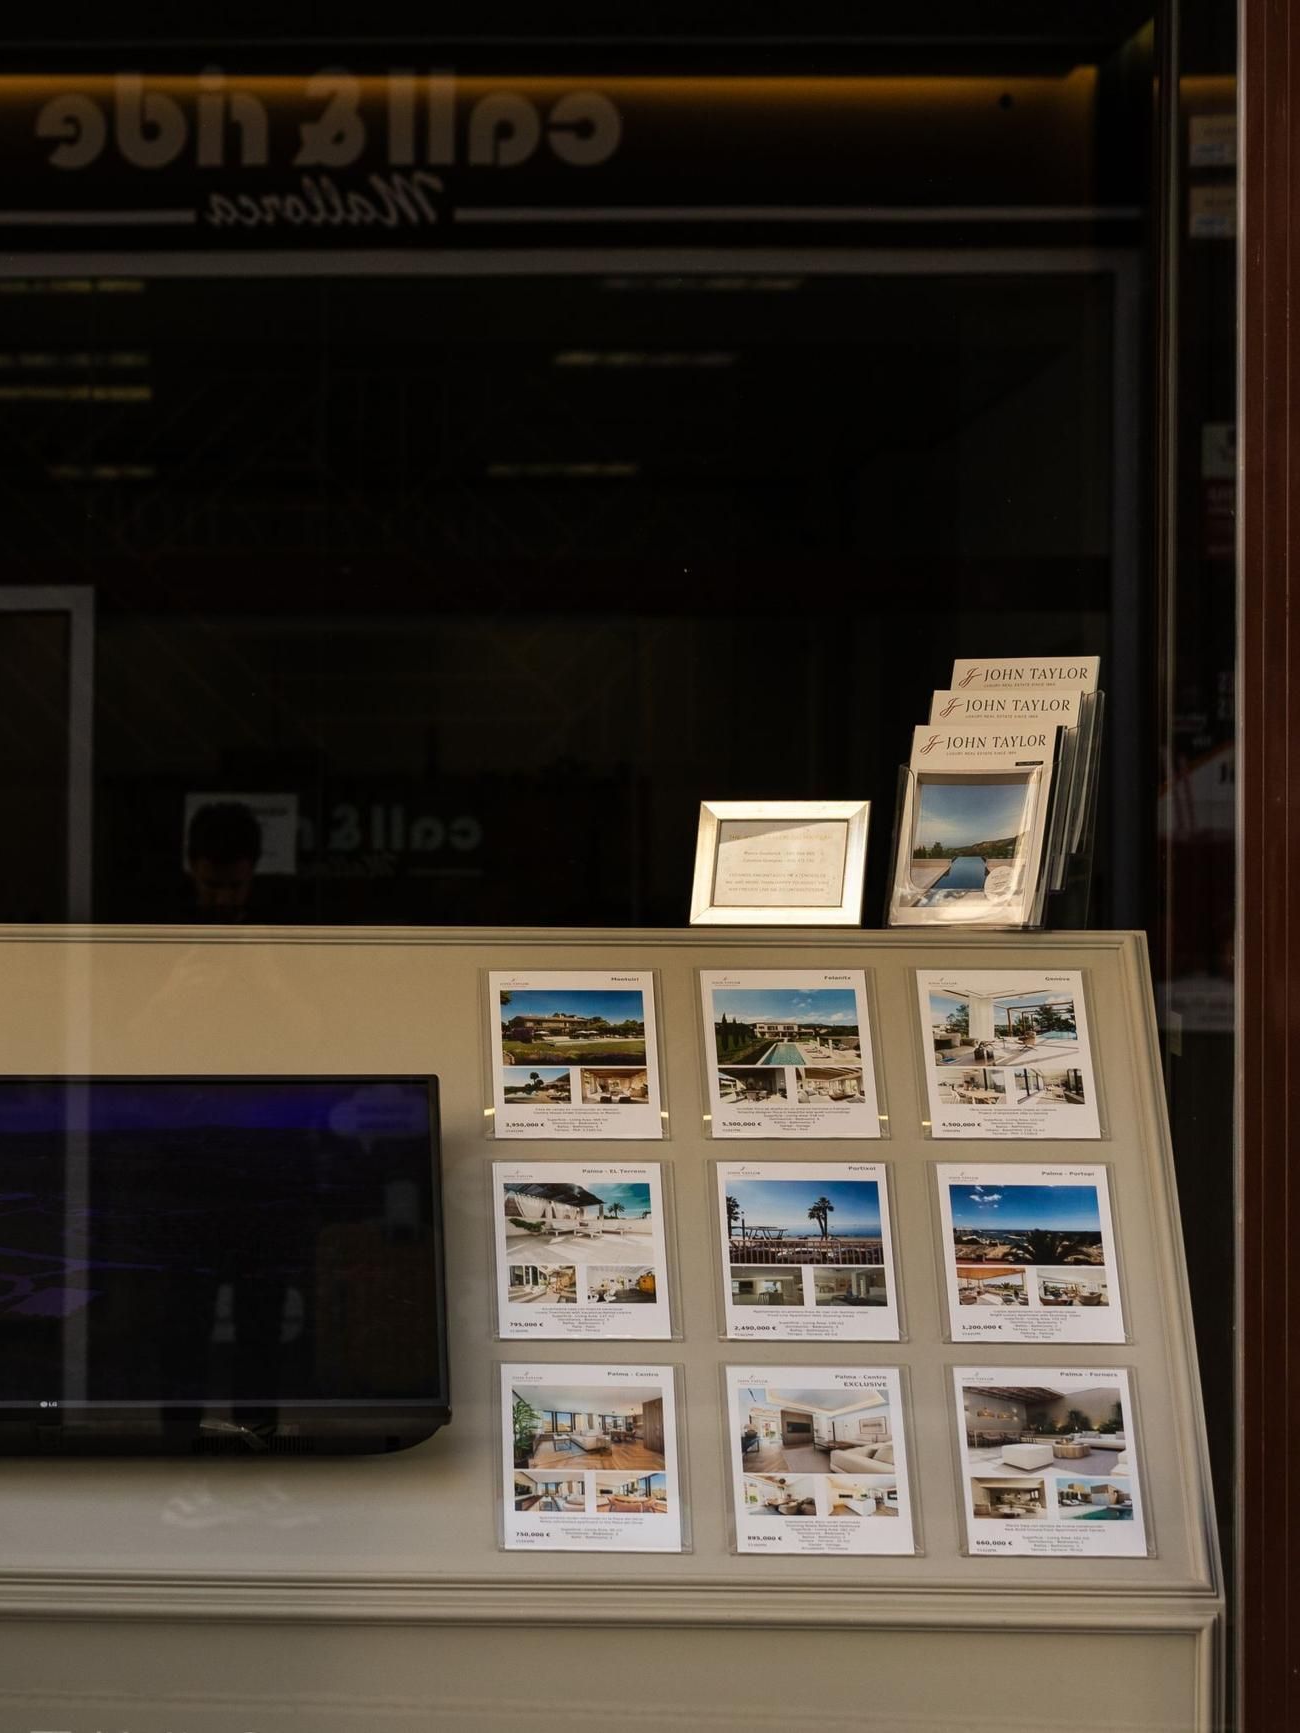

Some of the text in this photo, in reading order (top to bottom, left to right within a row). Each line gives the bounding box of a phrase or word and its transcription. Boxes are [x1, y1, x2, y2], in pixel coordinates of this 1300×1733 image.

[984, 667, 1088, 682] JOHN TAYLOR
[966, 699, 1070, 713] JOHN TAYLOR
[946, 735, 1046, 750] JOHN TAYLOR
